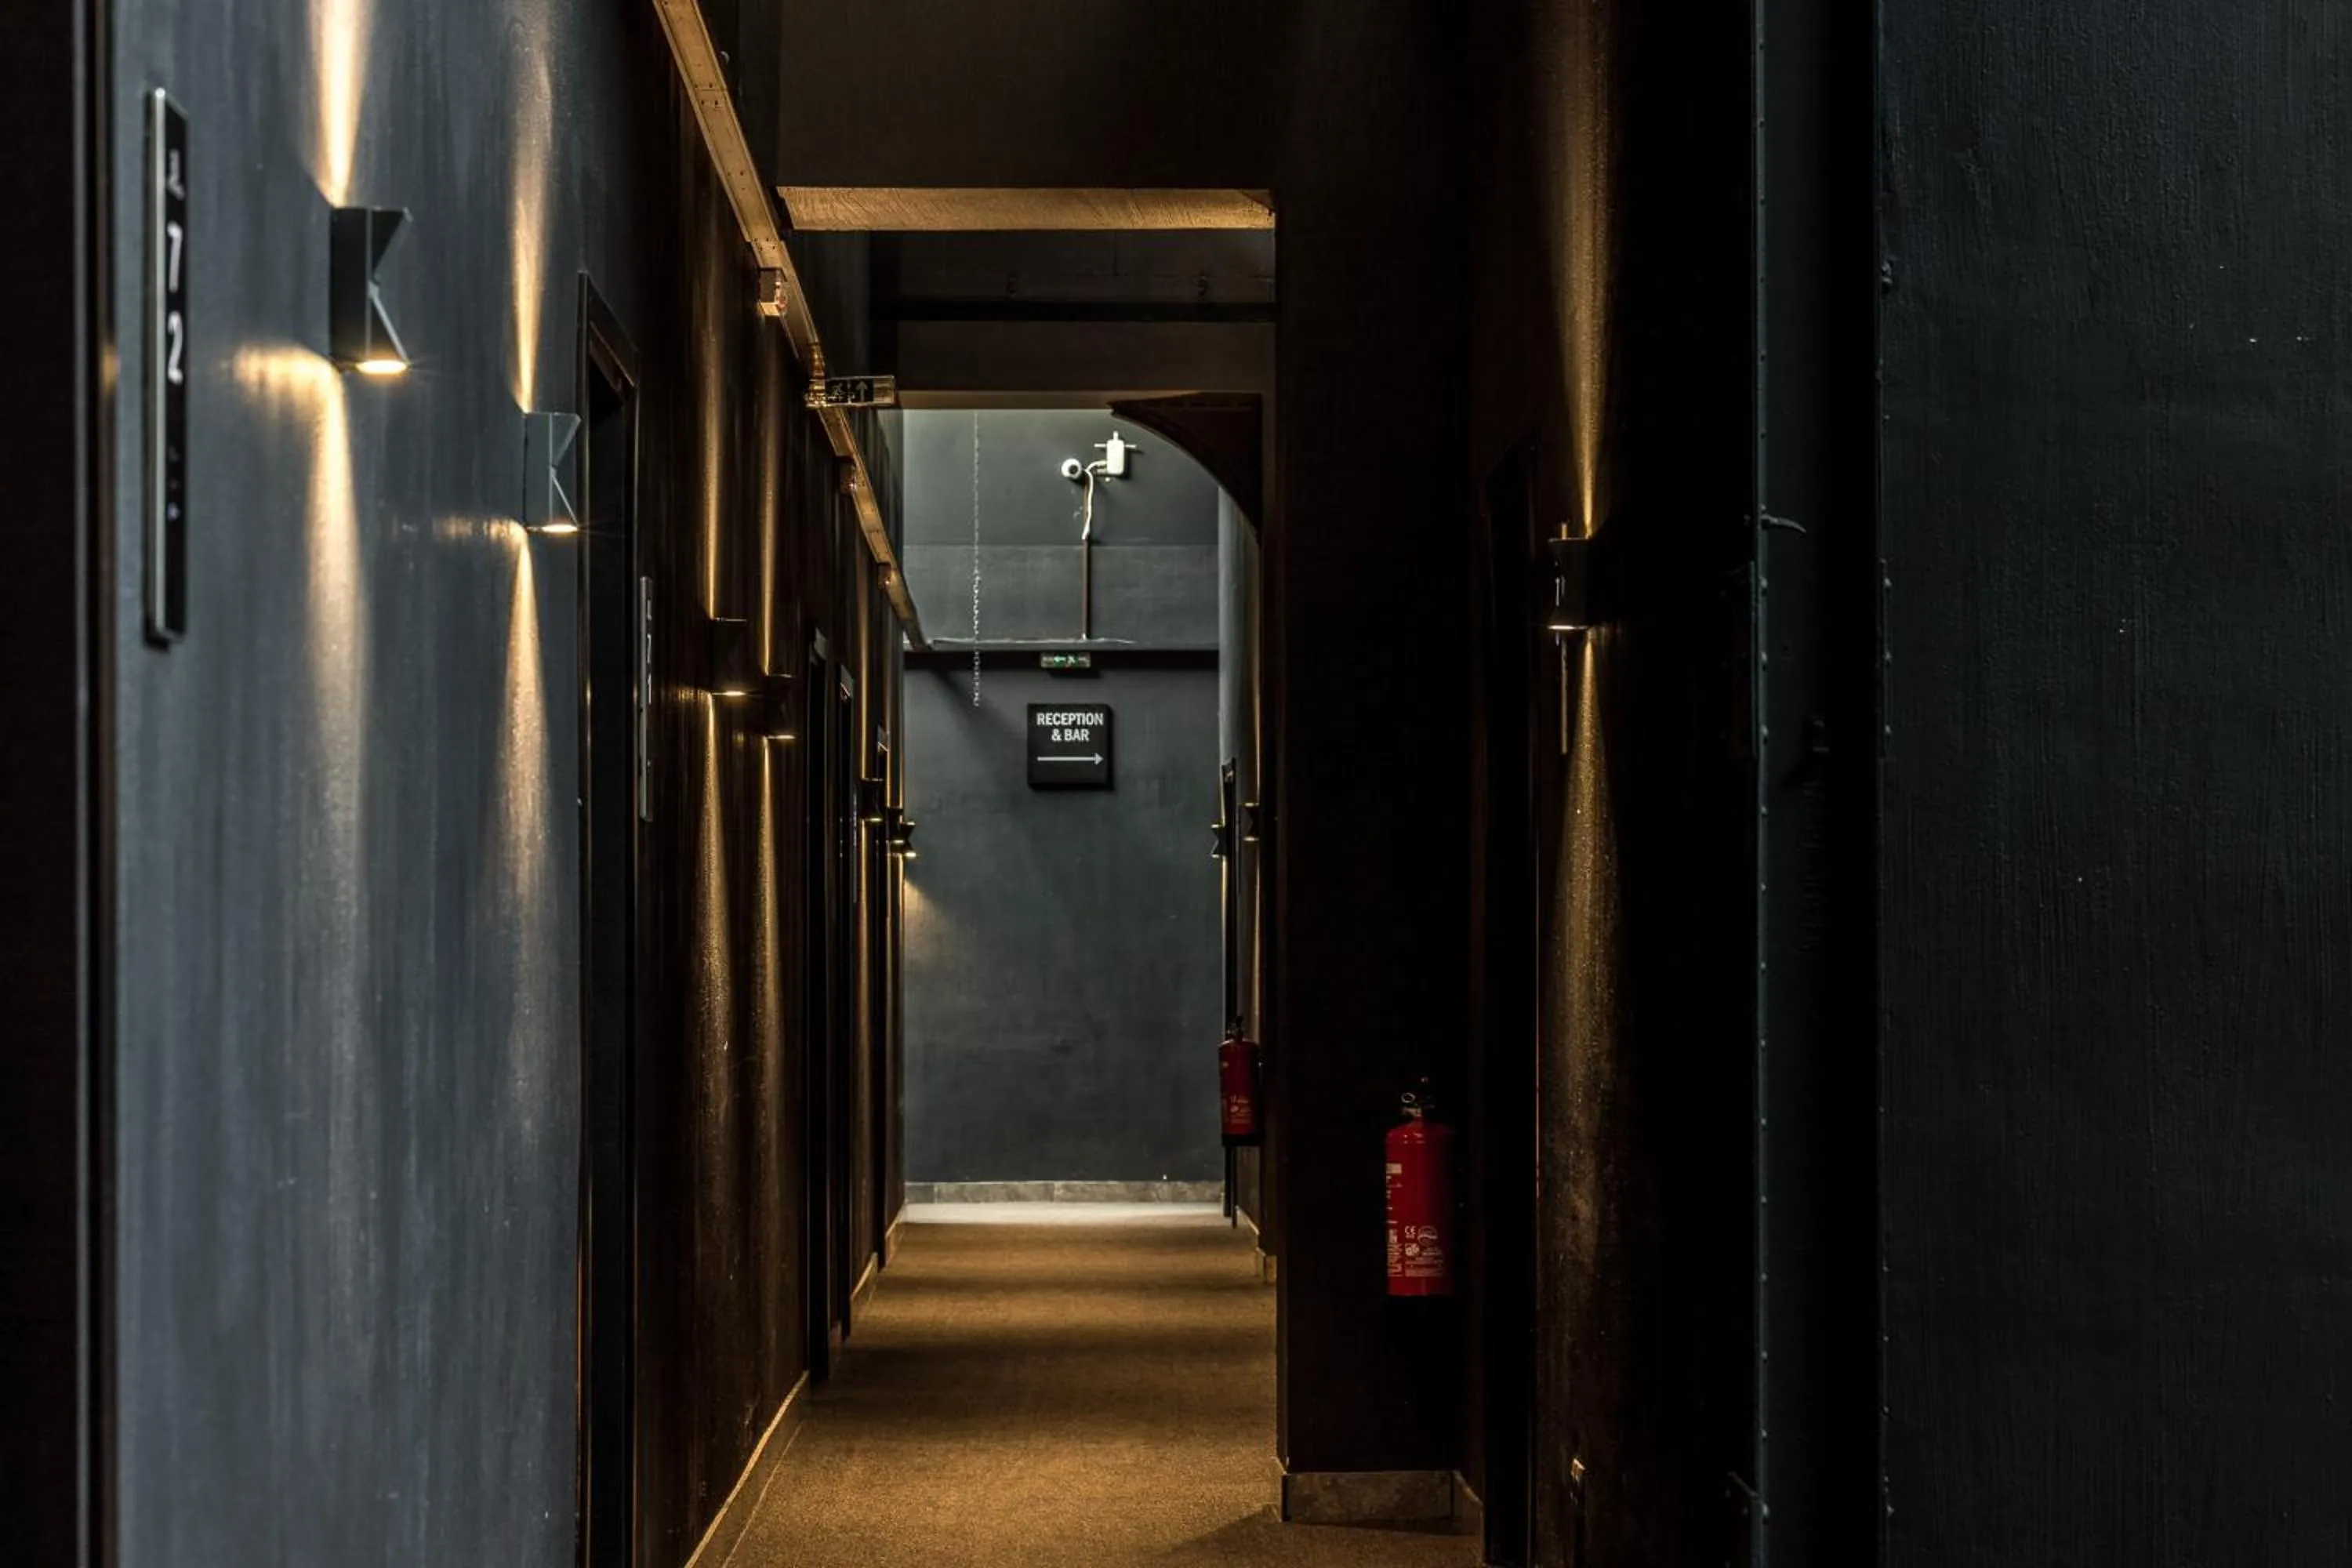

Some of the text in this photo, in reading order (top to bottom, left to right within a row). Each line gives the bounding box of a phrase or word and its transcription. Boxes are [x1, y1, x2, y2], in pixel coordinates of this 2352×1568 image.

[1036, 712, 1104, 726] RECEPTION
[1051, 728, 1090, 742] & BAR
